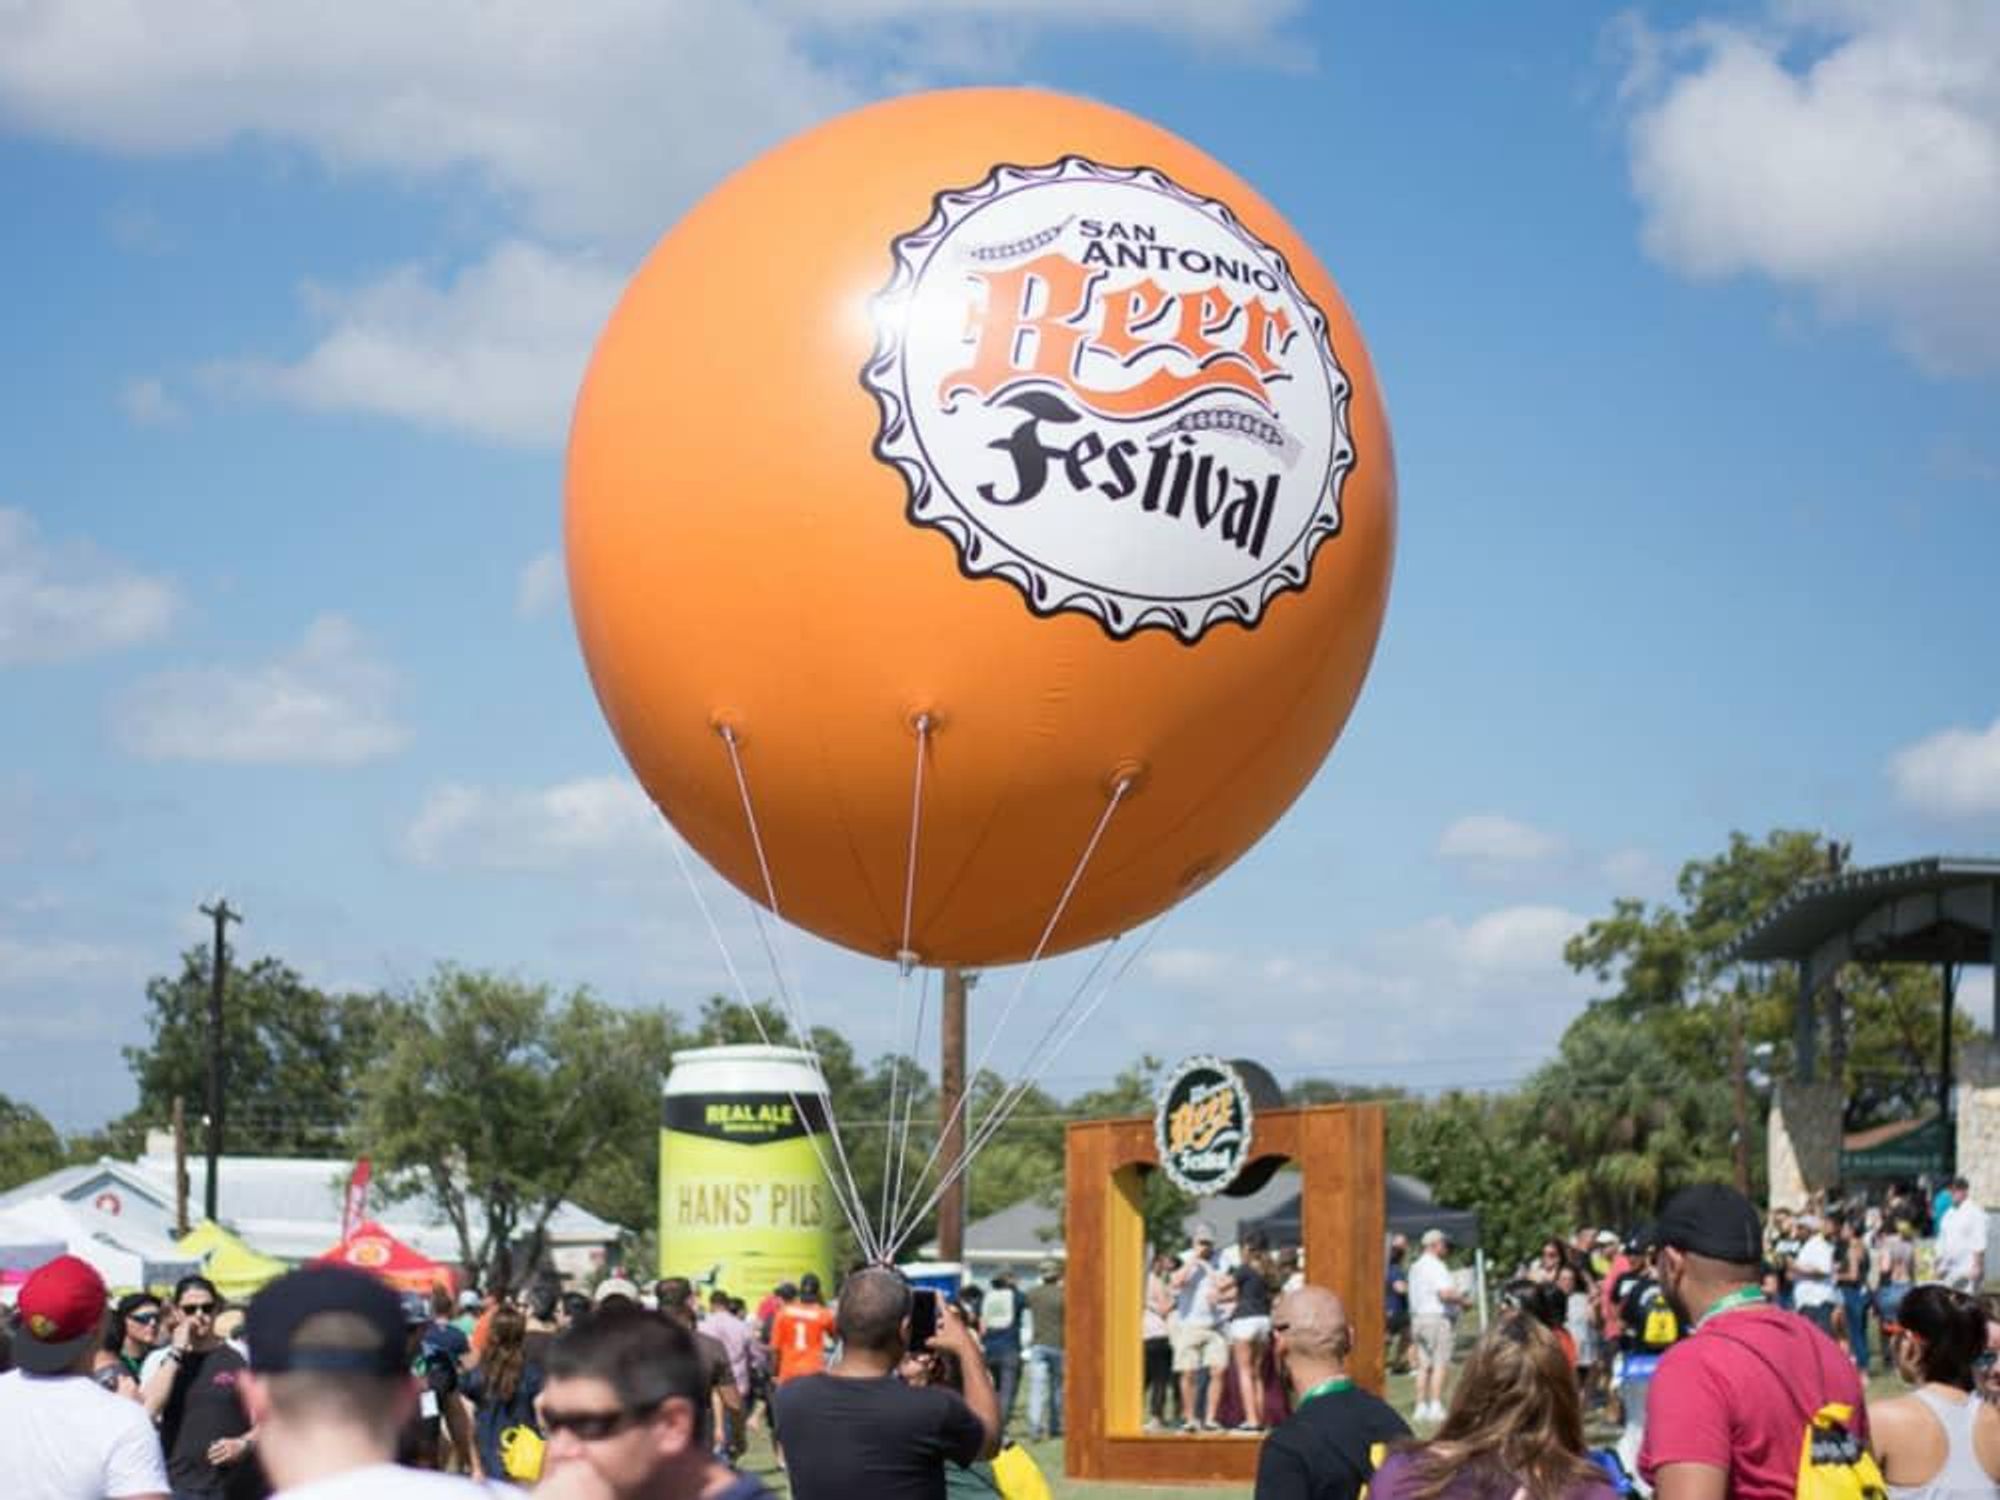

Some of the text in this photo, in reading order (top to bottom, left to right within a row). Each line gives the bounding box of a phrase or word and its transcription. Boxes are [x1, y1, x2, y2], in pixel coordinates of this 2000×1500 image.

[1079, 218, 1157, 244] SAN
[1082, 240, 1281, 293] ANTONIO
[938, 252, 1299, 420] Beer
[976, 389, 1281, 561] Festival
[771, 1183, 823, 1227] PILS
